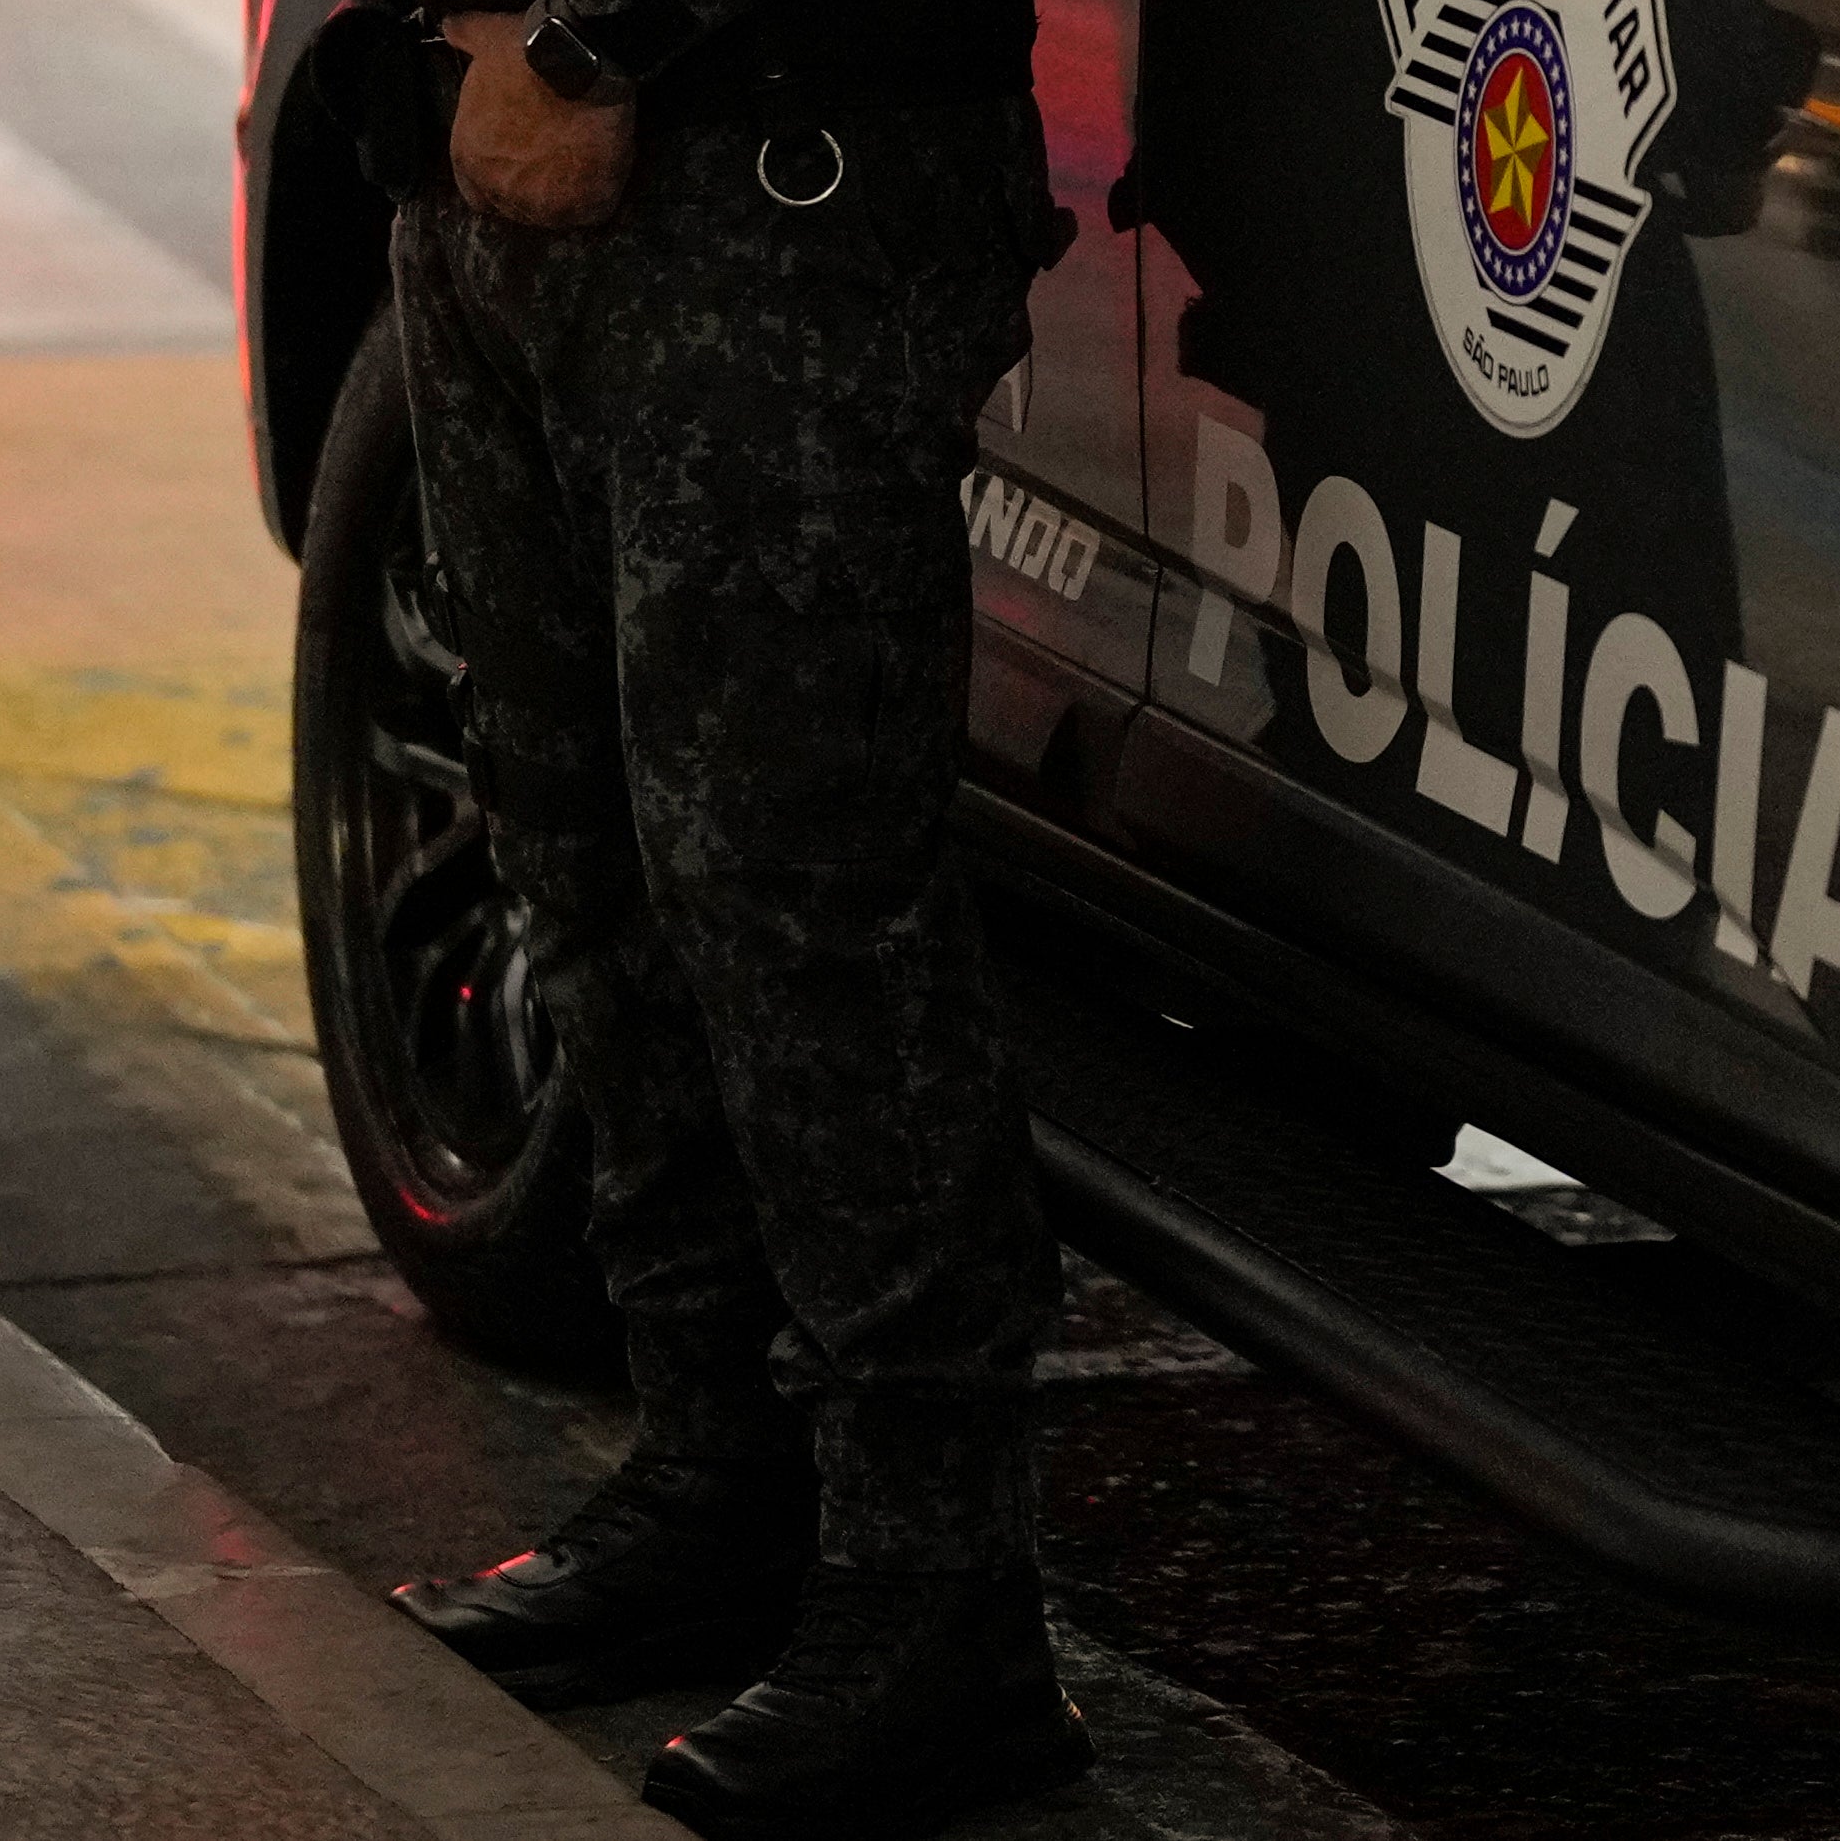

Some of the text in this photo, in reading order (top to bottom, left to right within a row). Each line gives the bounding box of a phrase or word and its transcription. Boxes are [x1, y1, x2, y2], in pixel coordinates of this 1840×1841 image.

[1462, 325, 1550, 397] SÃO PAULO
[959, 469, 1100, 602] NDO
